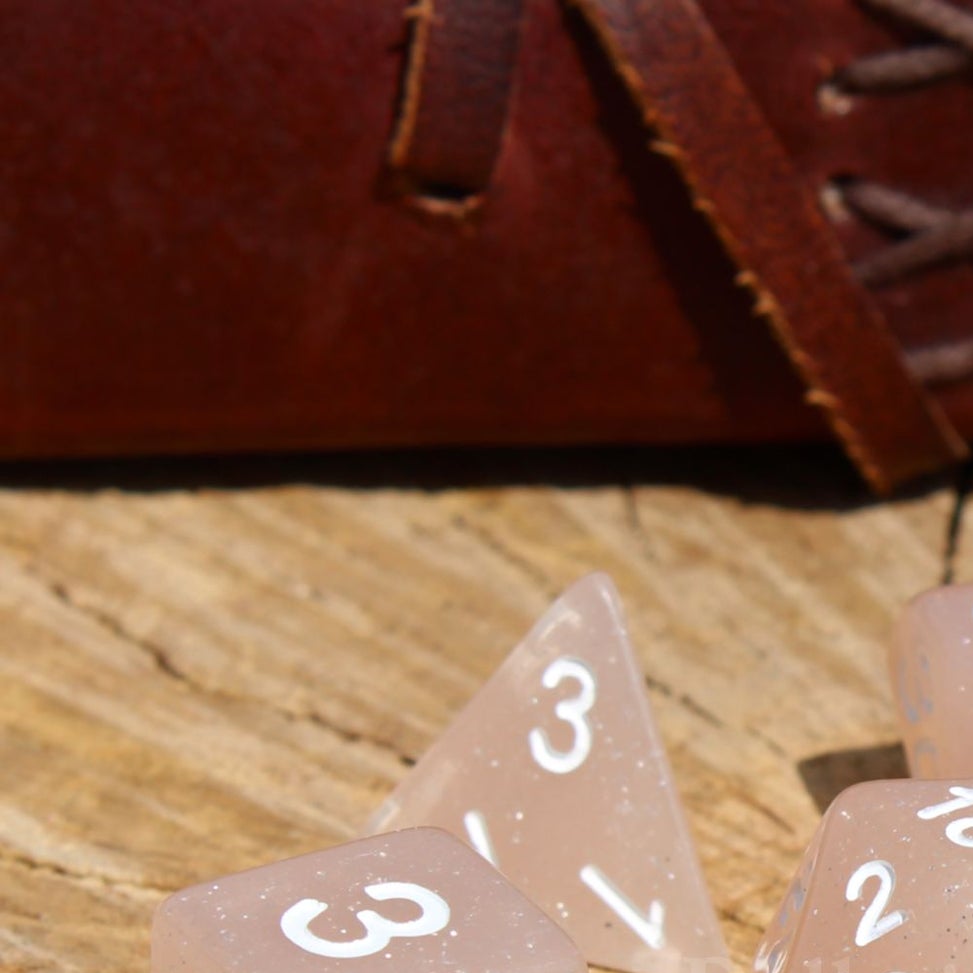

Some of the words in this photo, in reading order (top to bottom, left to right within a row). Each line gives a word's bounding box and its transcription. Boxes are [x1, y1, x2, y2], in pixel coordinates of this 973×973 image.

[529, 657, 597, 774] 3
[280, 881, 450, 958] 3
[846, 860, 907, 947] 2
